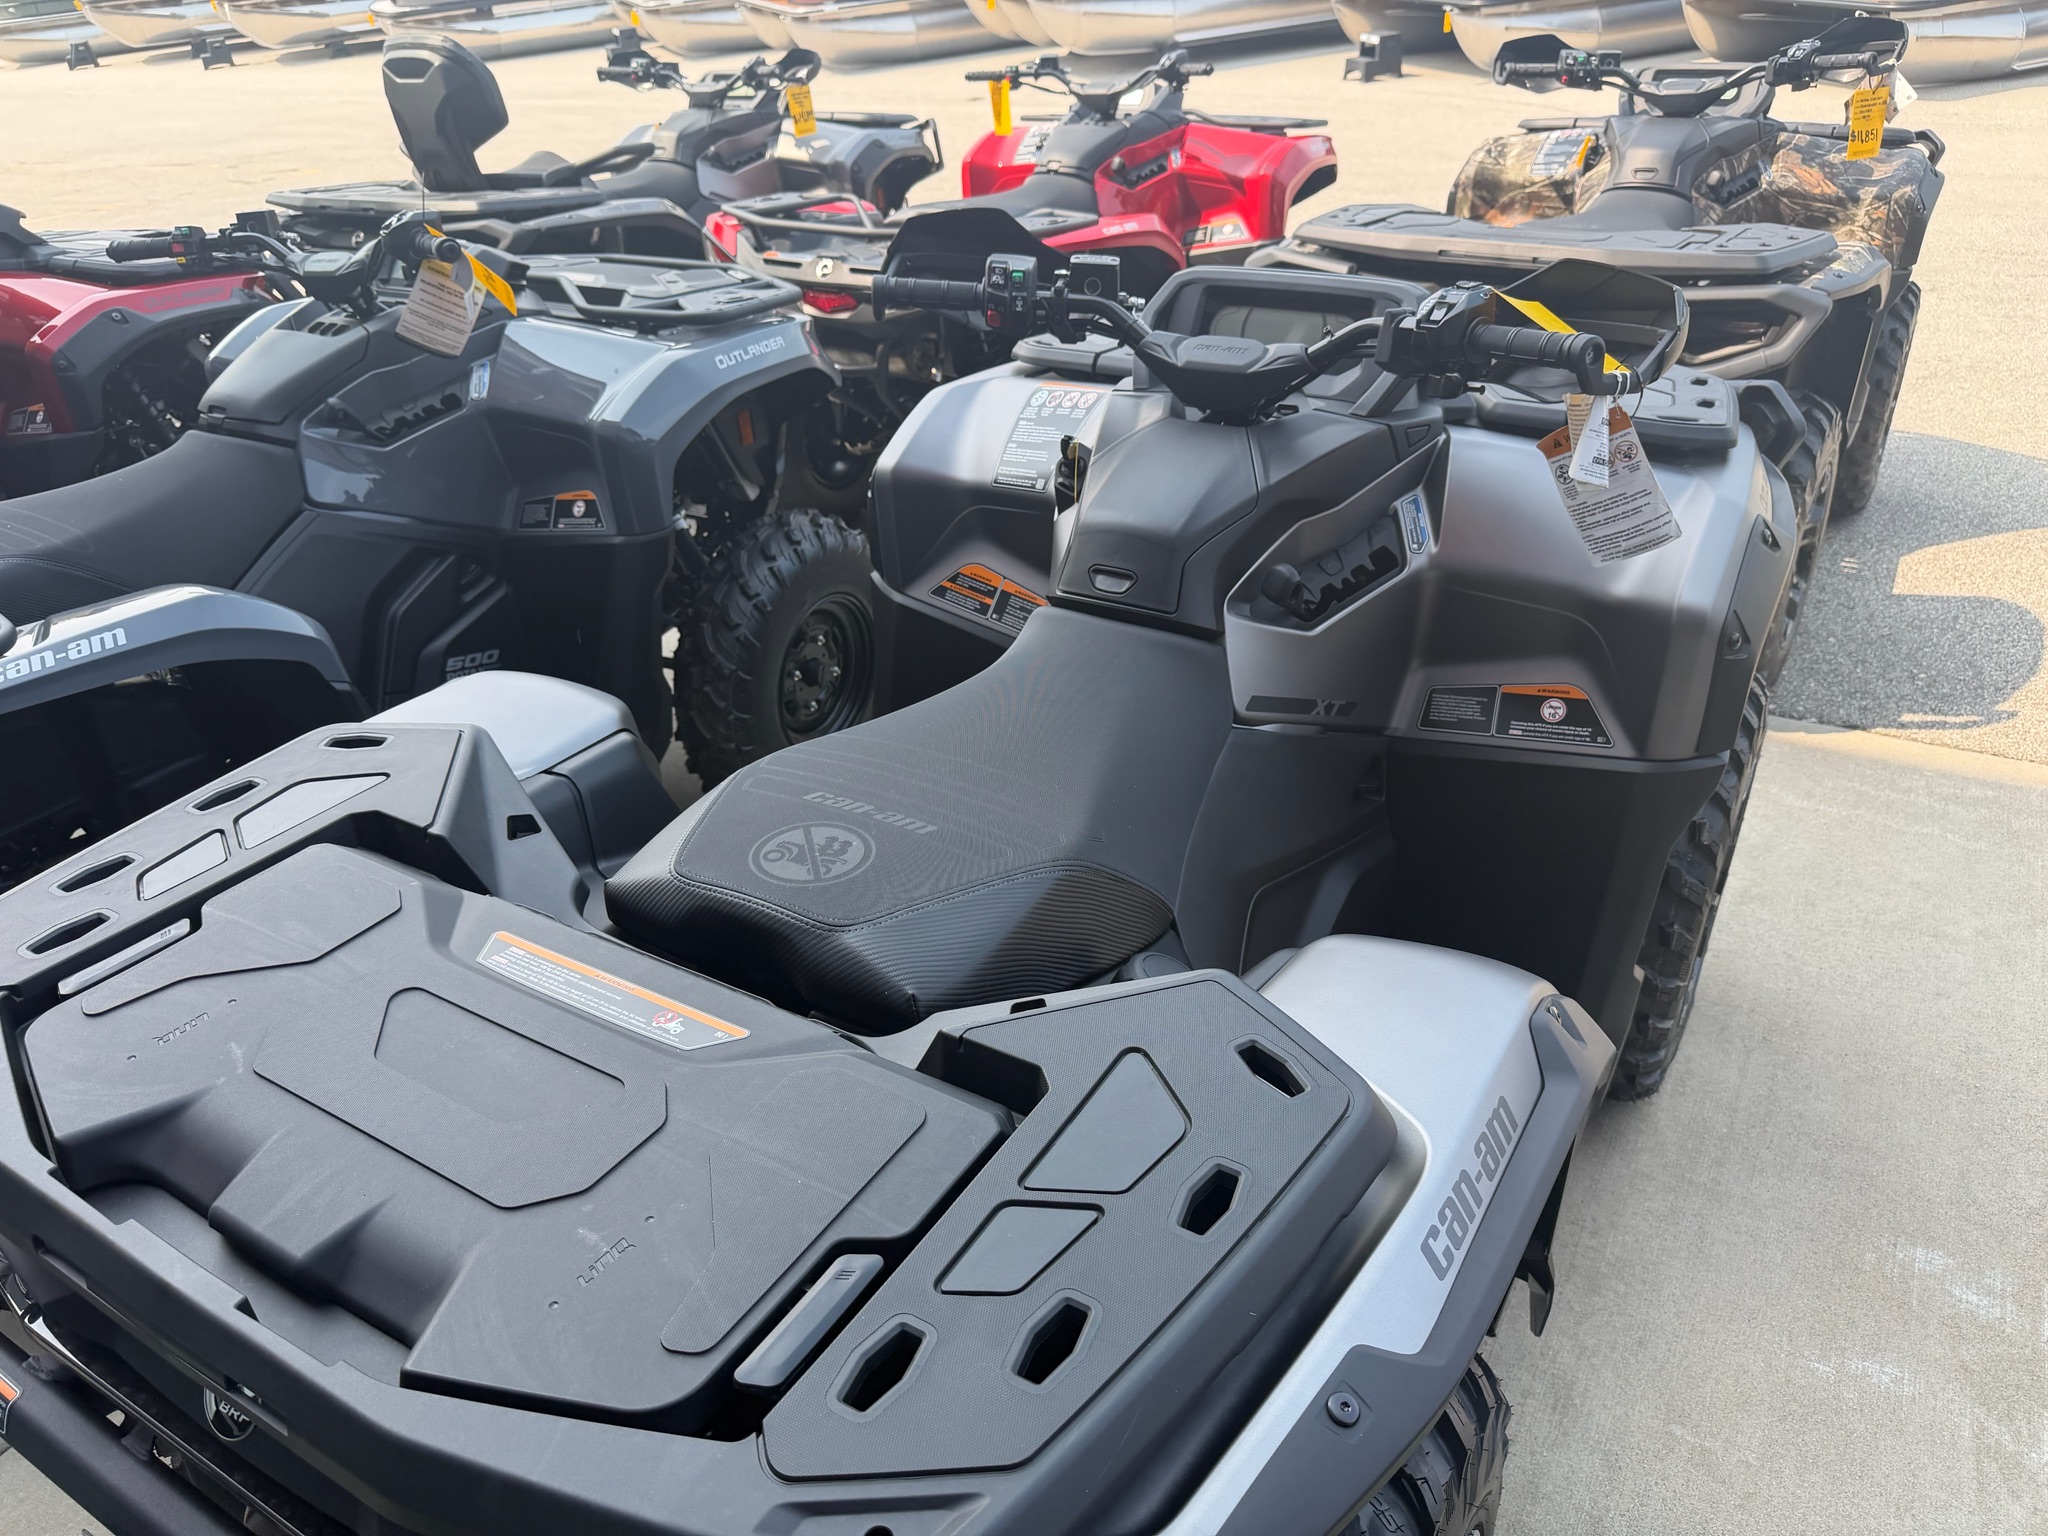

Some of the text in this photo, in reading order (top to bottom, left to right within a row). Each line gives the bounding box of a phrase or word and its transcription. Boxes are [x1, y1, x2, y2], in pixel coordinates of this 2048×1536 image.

[714, 336, 785, 369] OUTLANDER
[0, 628, 127, 683] an-am
[446, 648, 500, 672] 500
[1541, 688, 1571, 696] WARNING
[1310, 699, 1346, 716] XT
[1547, 712, 1557, 720] 16
[802, 792, 938, 833] can-am
[600, 975, 637, 992] WARNING
[1420, 1095, 1519, 1281] can-am
